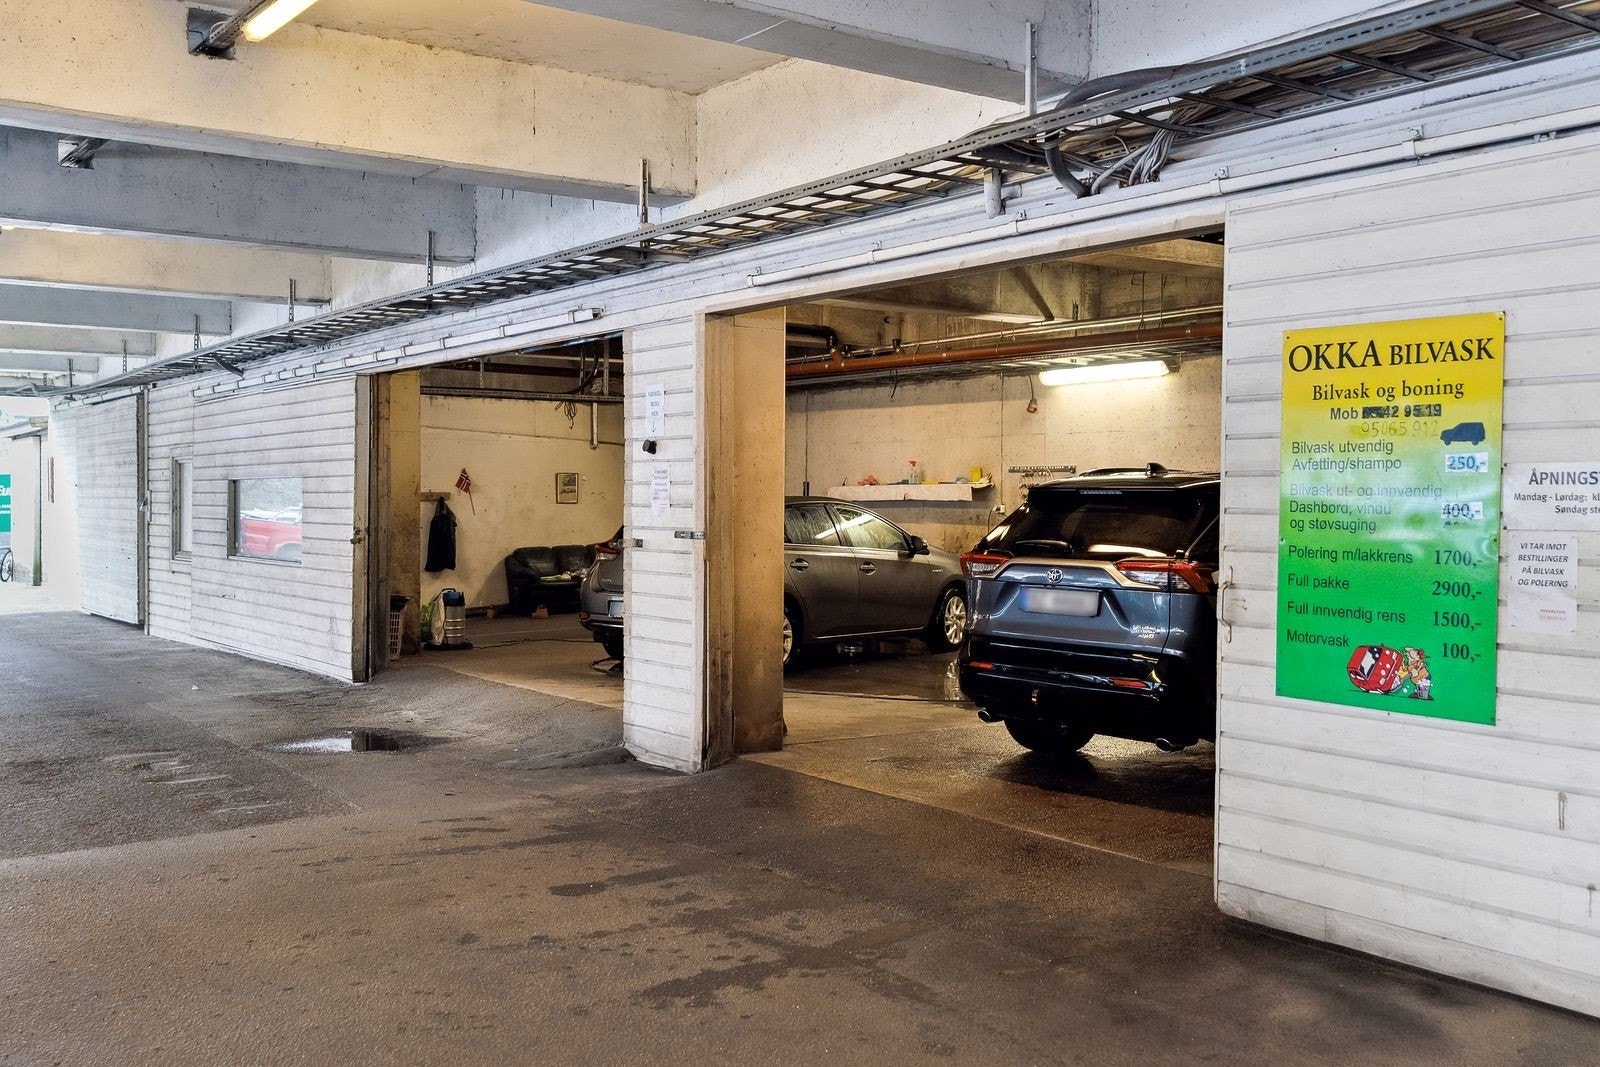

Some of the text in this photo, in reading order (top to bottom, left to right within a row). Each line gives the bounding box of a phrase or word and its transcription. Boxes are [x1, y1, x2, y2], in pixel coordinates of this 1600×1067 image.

[1288, 337, 1495, 372] OKKA BILVASK
[1312, 378, 1465, 402] Bilvask og boning
[1330, 405, 1359, 420] Mob
[1292, 439, 1394, 455] Bilvask utvendig
[1292, 456, 1401, 472] Avfetting/shampo
[1528, 467, 1600, 485] ÅPNINGS
[1290, 483, 1442, 500] Bilvask ut- og innvendig
[1513, 493, 1547, 502] Mandag
[1555, 493, 1588, 502] Lørdag:
[1357, 503, 1392, 515] vindu
[1554, 505, 1588, 515] Søndag
[1289, 518, 1377, 534] og støvsuging
[1288, 545, 1413, 563] Polering m/lakkrens
[1434, 549, 1483, 568] 1700,-
[1518, 554, 1568, 562] BESTILLINGER
[1521, 565, 1565, 575] PÅ BILVASK
[1287, 573, 1350, 590] Full pakke
[1517, 578, 1568, 587] OG POLERING
[1432, 581, 1482, 600] 2900,-
[1287, 601, 1406, 623] Full innvendig rens
[1432, 611, 1482, 631] 1500,-
[1286, 629, 1350, 648] Motorvask
[1441, 643, 1481, 662] 100,-
